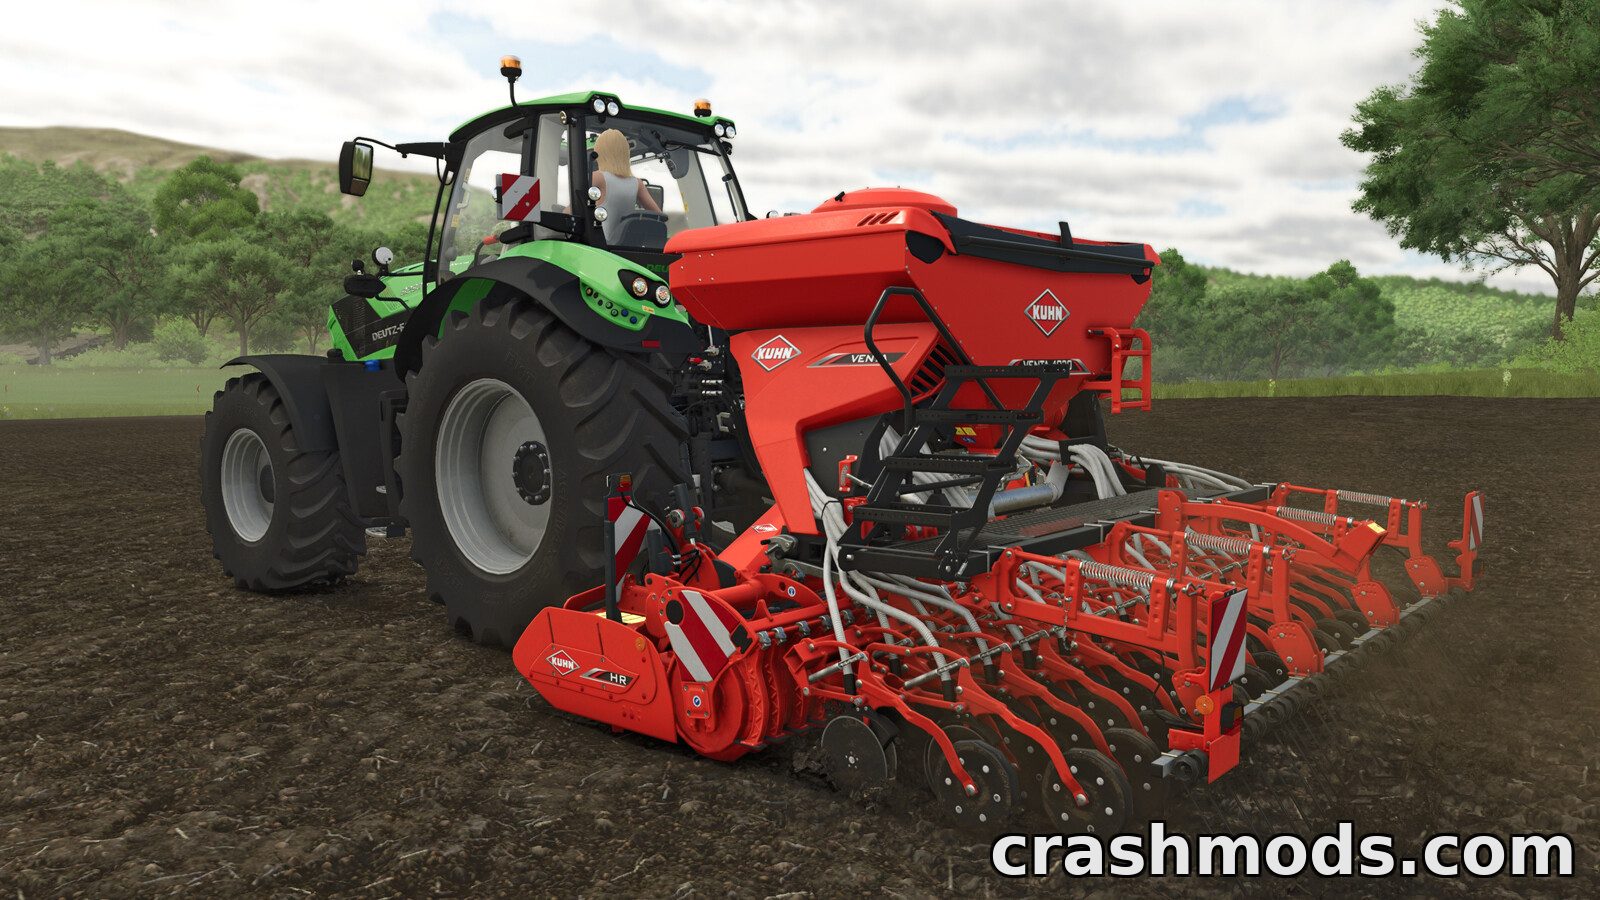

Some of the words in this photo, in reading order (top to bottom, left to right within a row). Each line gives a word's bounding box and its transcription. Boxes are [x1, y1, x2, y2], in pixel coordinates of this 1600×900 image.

[1032, 304, 1063, 321] KUHN
[371, 322, 407, 341] DEUTZ-F
[757, 347, 793, 360] KUHN
[551, 656, 575, 670] KUHN
[609, 672, 627, 686] HR
